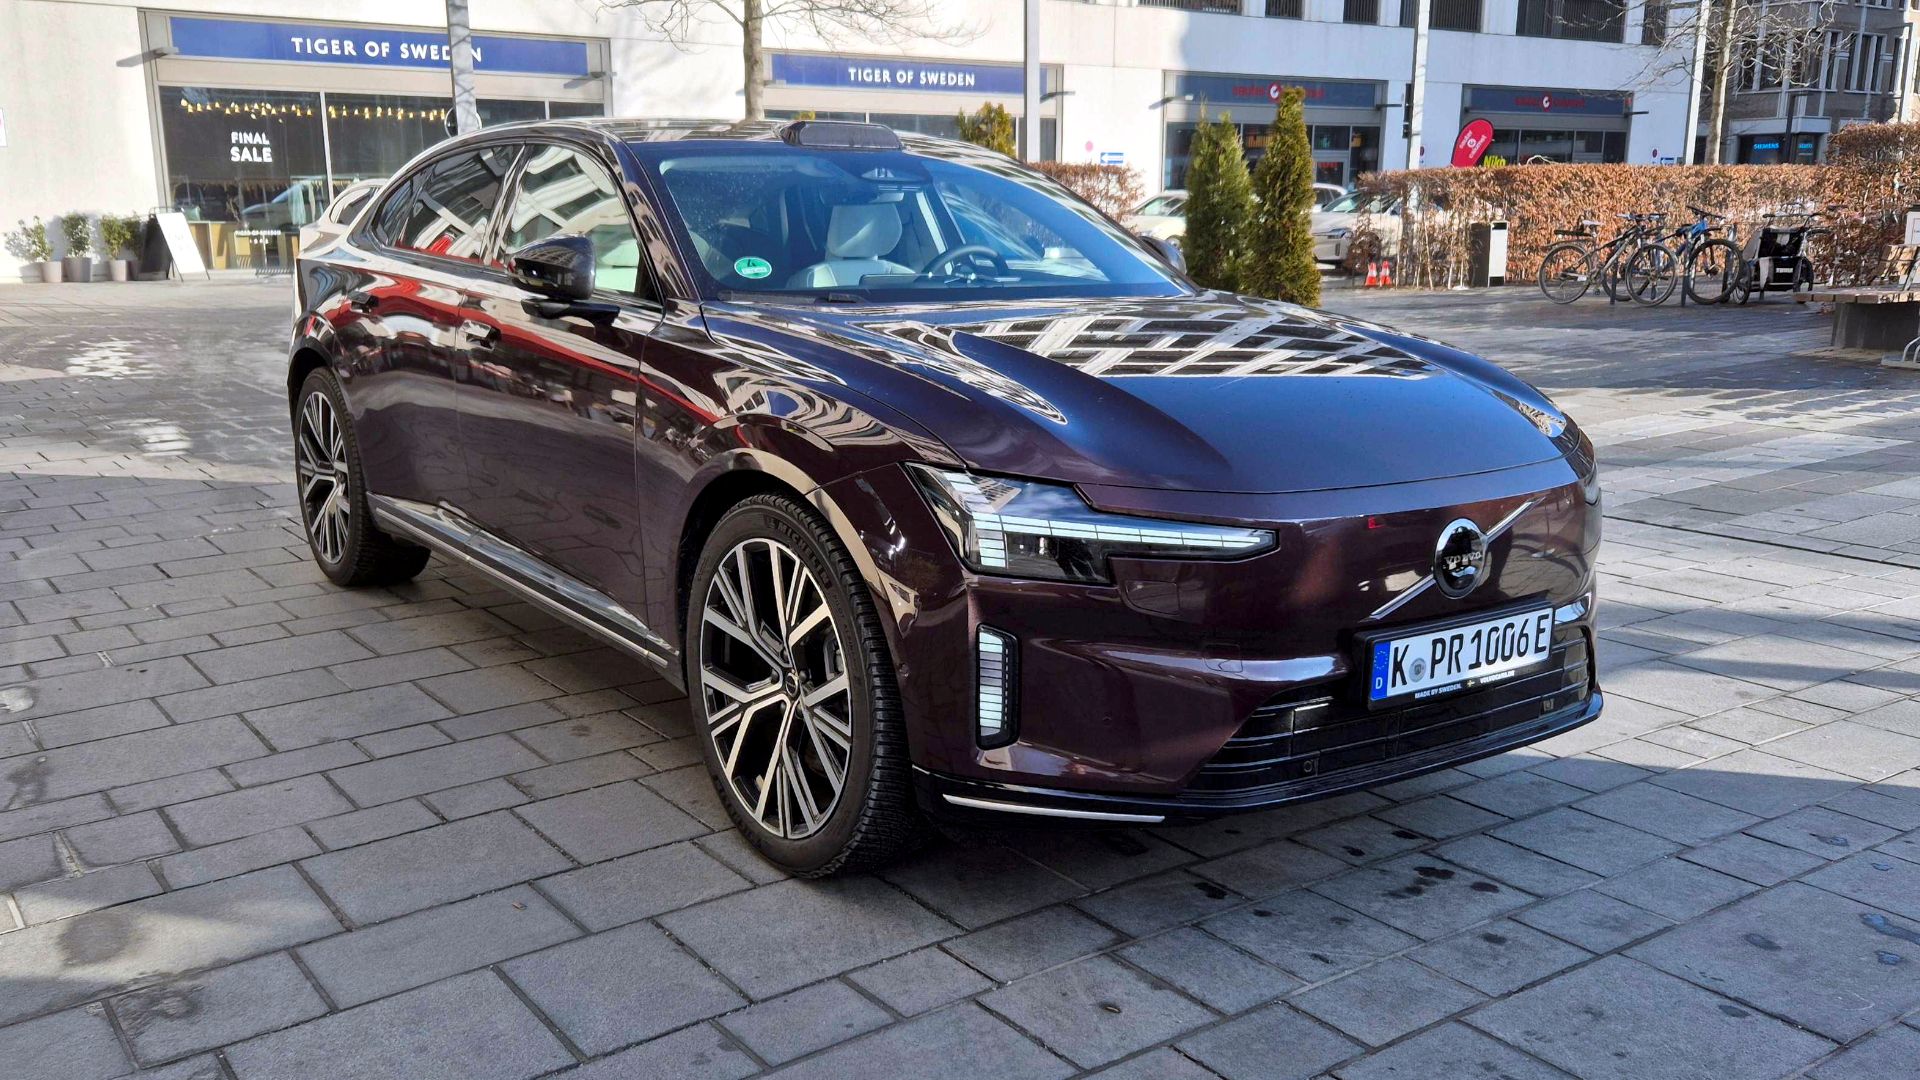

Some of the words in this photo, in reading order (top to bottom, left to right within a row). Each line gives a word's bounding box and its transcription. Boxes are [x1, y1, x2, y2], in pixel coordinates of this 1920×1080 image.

[291, 37, 357, 56] TIGER
[364, 41, 390, 58] OF
[848, 67, 891, 82] TIGER
[896, 69, 914, 84] OF
[920, 71, 976, 87] SWEDEN
[231, 131, 270, 145] FINAL
[230, 146, 273, 162] SALE
[777, 518, 830, 586] MICHELIN
[1375, 677, 1383, 690] D
[1391, 643, 1410, 688] K
[1414, 690, 1430, 699] MADE
